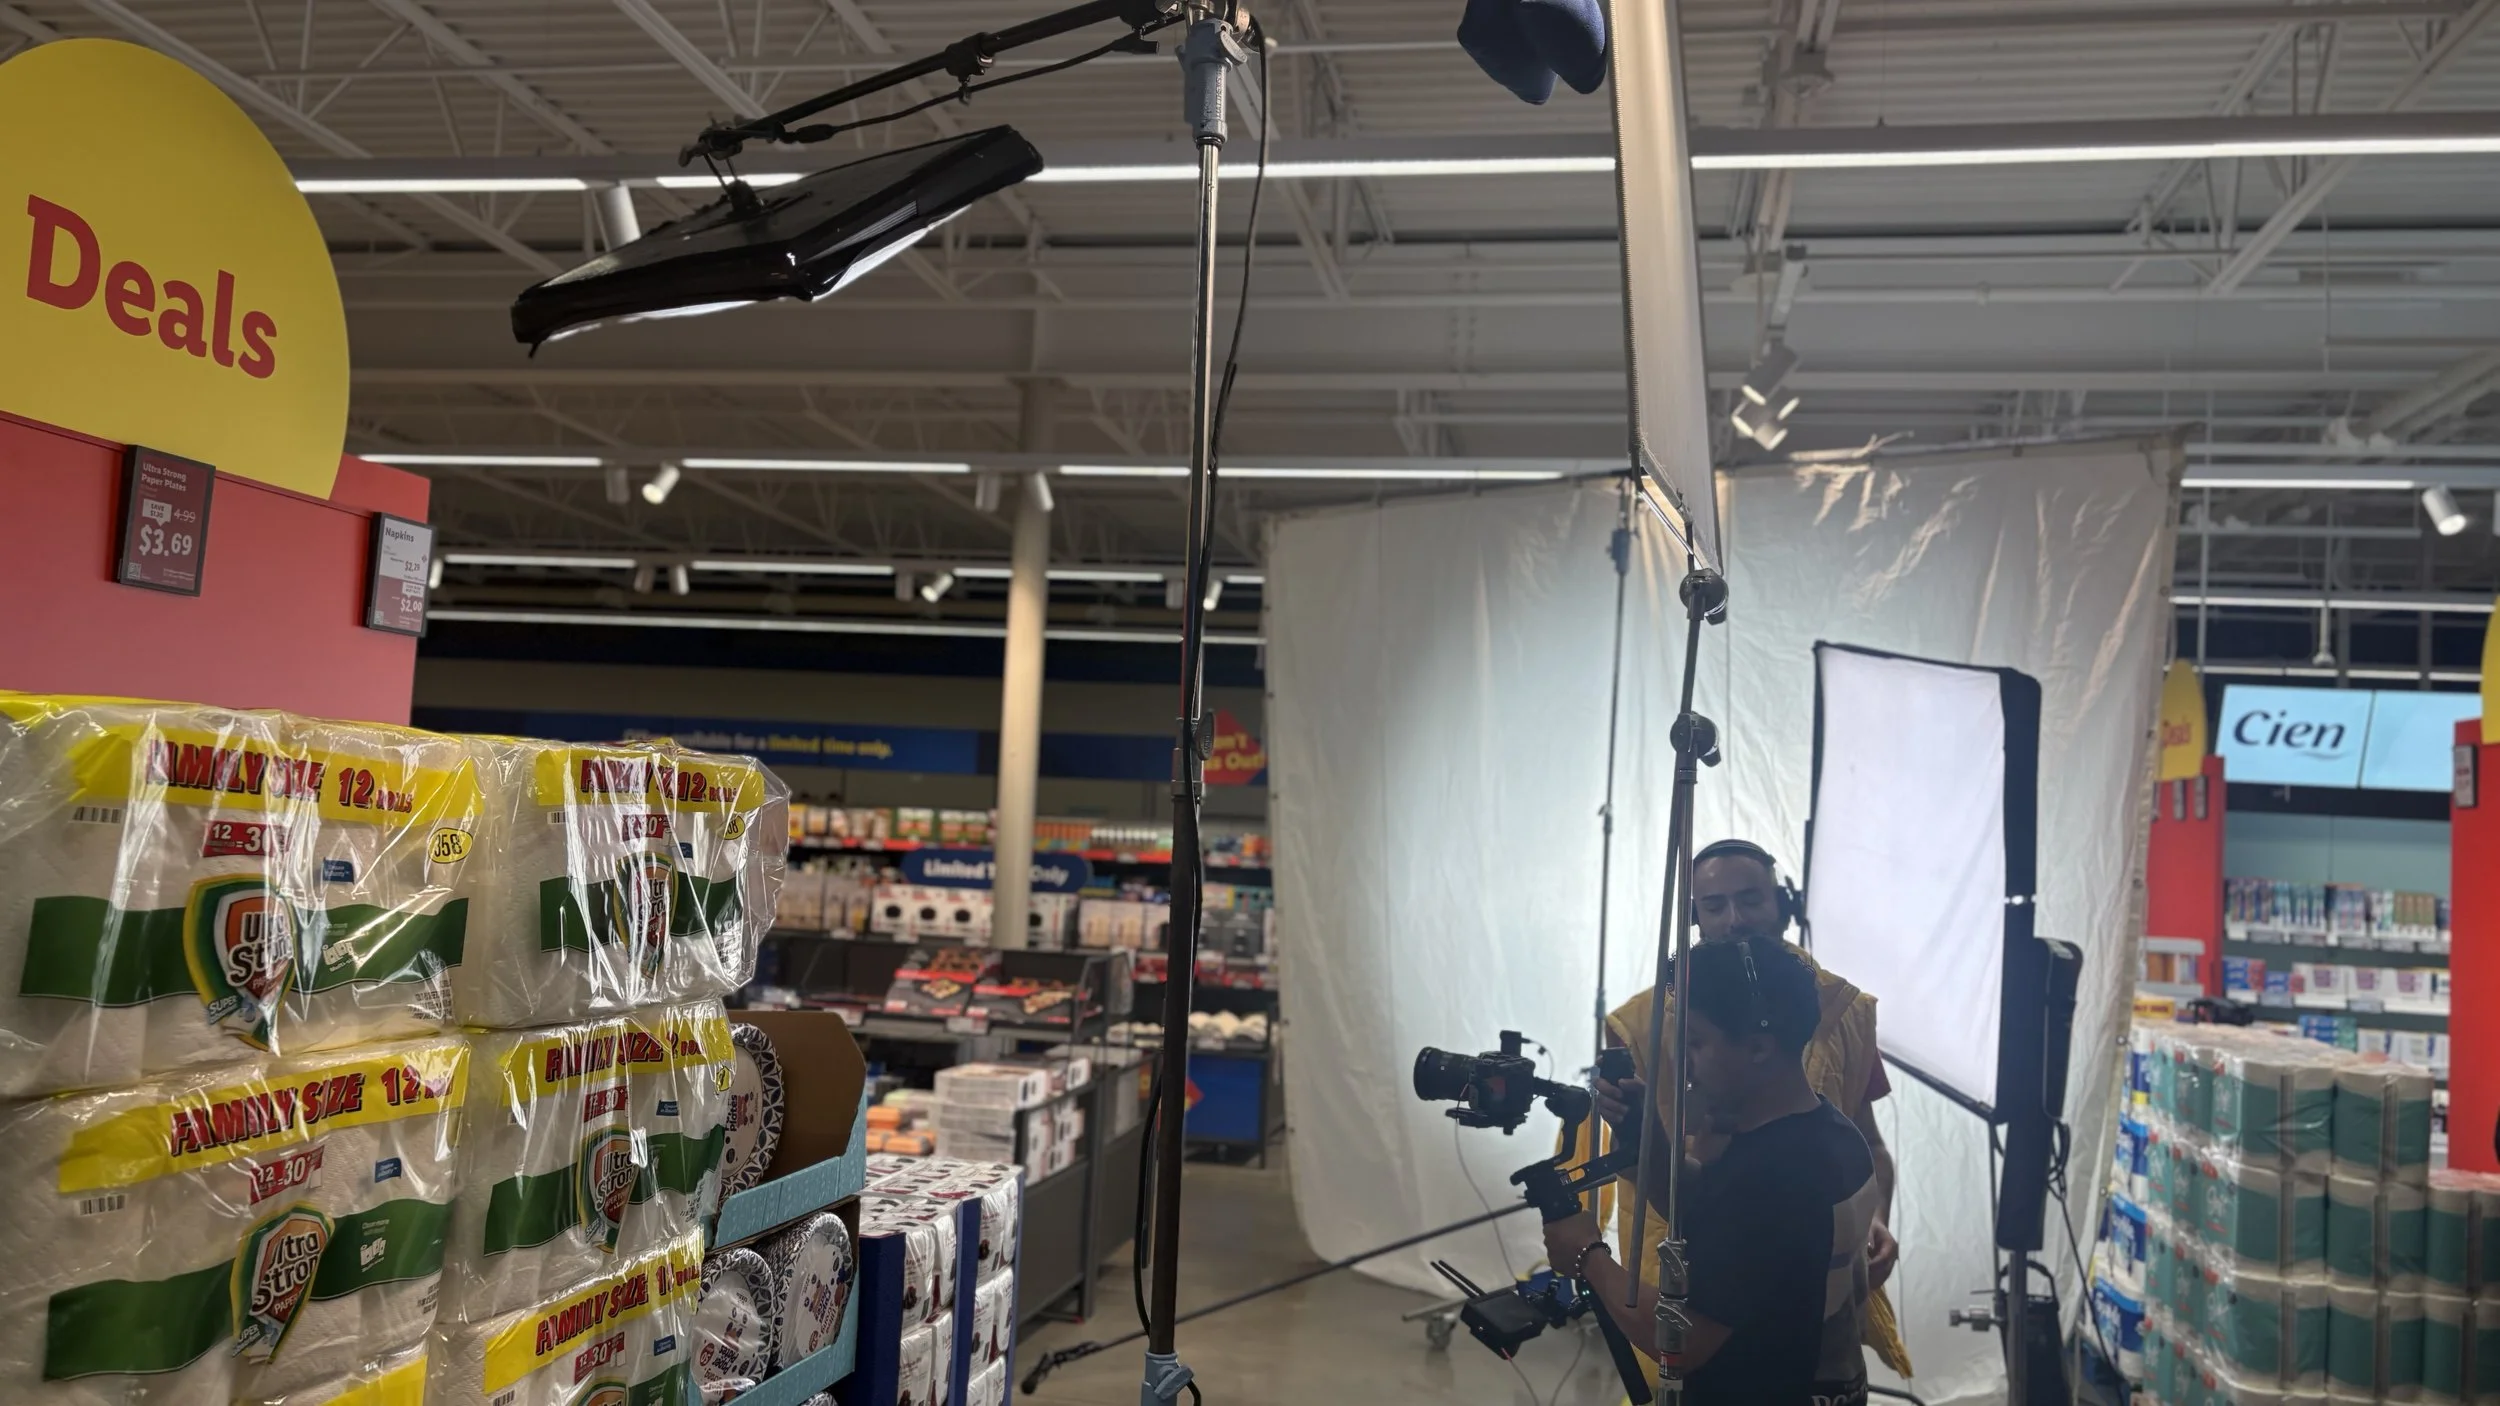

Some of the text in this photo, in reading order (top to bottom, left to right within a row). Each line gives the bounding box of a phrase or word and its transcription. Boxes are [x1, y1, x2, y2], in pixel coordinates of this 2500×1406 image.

[26, 194, 278, 379] Deals
[141, 473, 163, 486] Paper
[164, 478, 187, 492] Plates
[142, 461, 187, 483] Ultra Strong
[173, 508, 196, 524] 4.99
[139, 524, 193, 556] $3.69
[385, 526, 415, 543] Napkins
[400, 598, 423, 613] $2.00
[2233, 709, 2346, 749] Cien
[767, 733, 821, 754] limited
[822, 736, 855, 756] time
[1213, 732, 1248, 751] on't
[338, 767, 375, 809] 12
[376, 788, 414, 813] ROLLS
[212, 823, 233, 841] 12
[923, 858, 986, 880] Limited
[1028, 864, 1070, 888] Only
[170, 1087, 299, 1157] FAMILY
[300, 1072, 366, 1126] SIZE
[380, 1064, 421, 1106] 12
[729, 1094, 738, 1132] Plates
[256, 1165, 276, 1184] 12
[594, 1167, 634, 1213] Stron
[268, 1231, 321, 1270] ltra
[249, 1254, 320, 1317] Stron
[273, 1293, 298, 1315] PAPE
[536, 1290, 610, 1356] FAMILY
[607, 1272, 650, 1319] SIZE
[579, 1353, 588, 1367] 12
[711, 1356, 731, 1374] Paper
